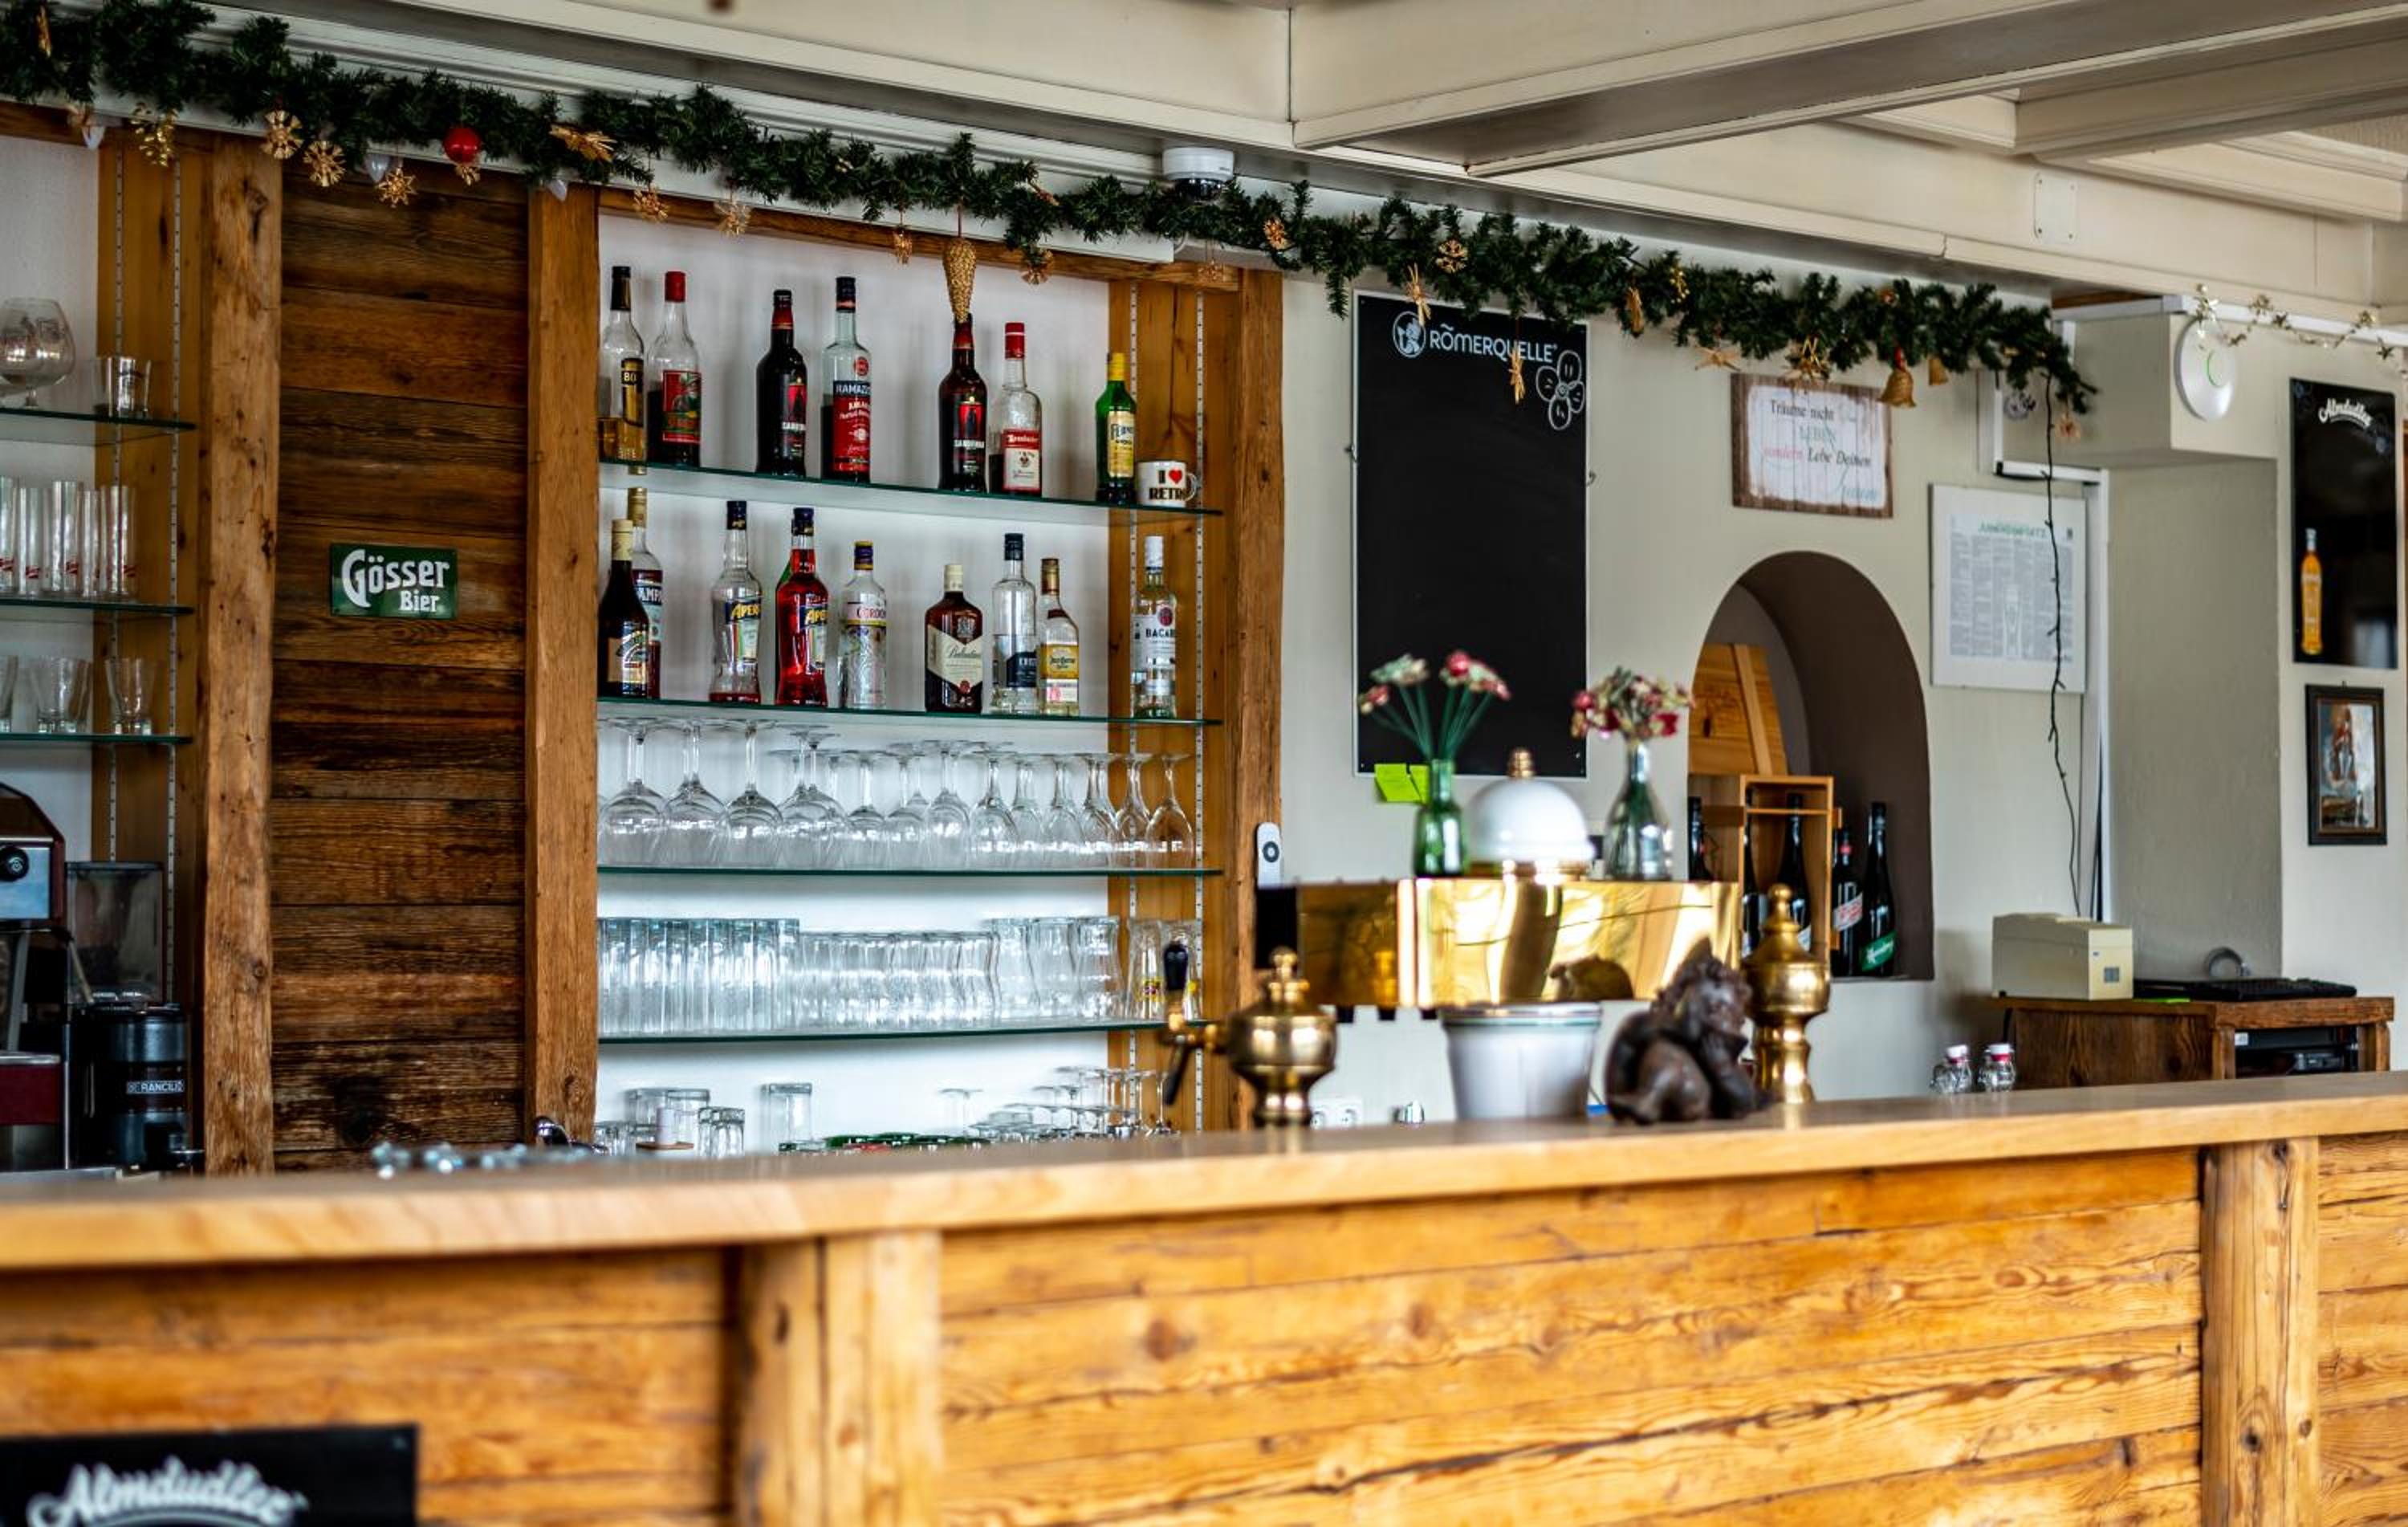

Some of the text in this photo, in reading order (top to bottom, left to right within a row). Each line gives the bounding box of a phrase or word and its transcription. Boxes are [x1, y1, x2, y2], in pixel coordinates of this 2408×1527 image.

[1158, 470, 1165, 483] I
[341, 548, 450, 608] Gösser
[398, 588, 441, 613] Bier
[26, 1456, 295, 1527] Almdudler
